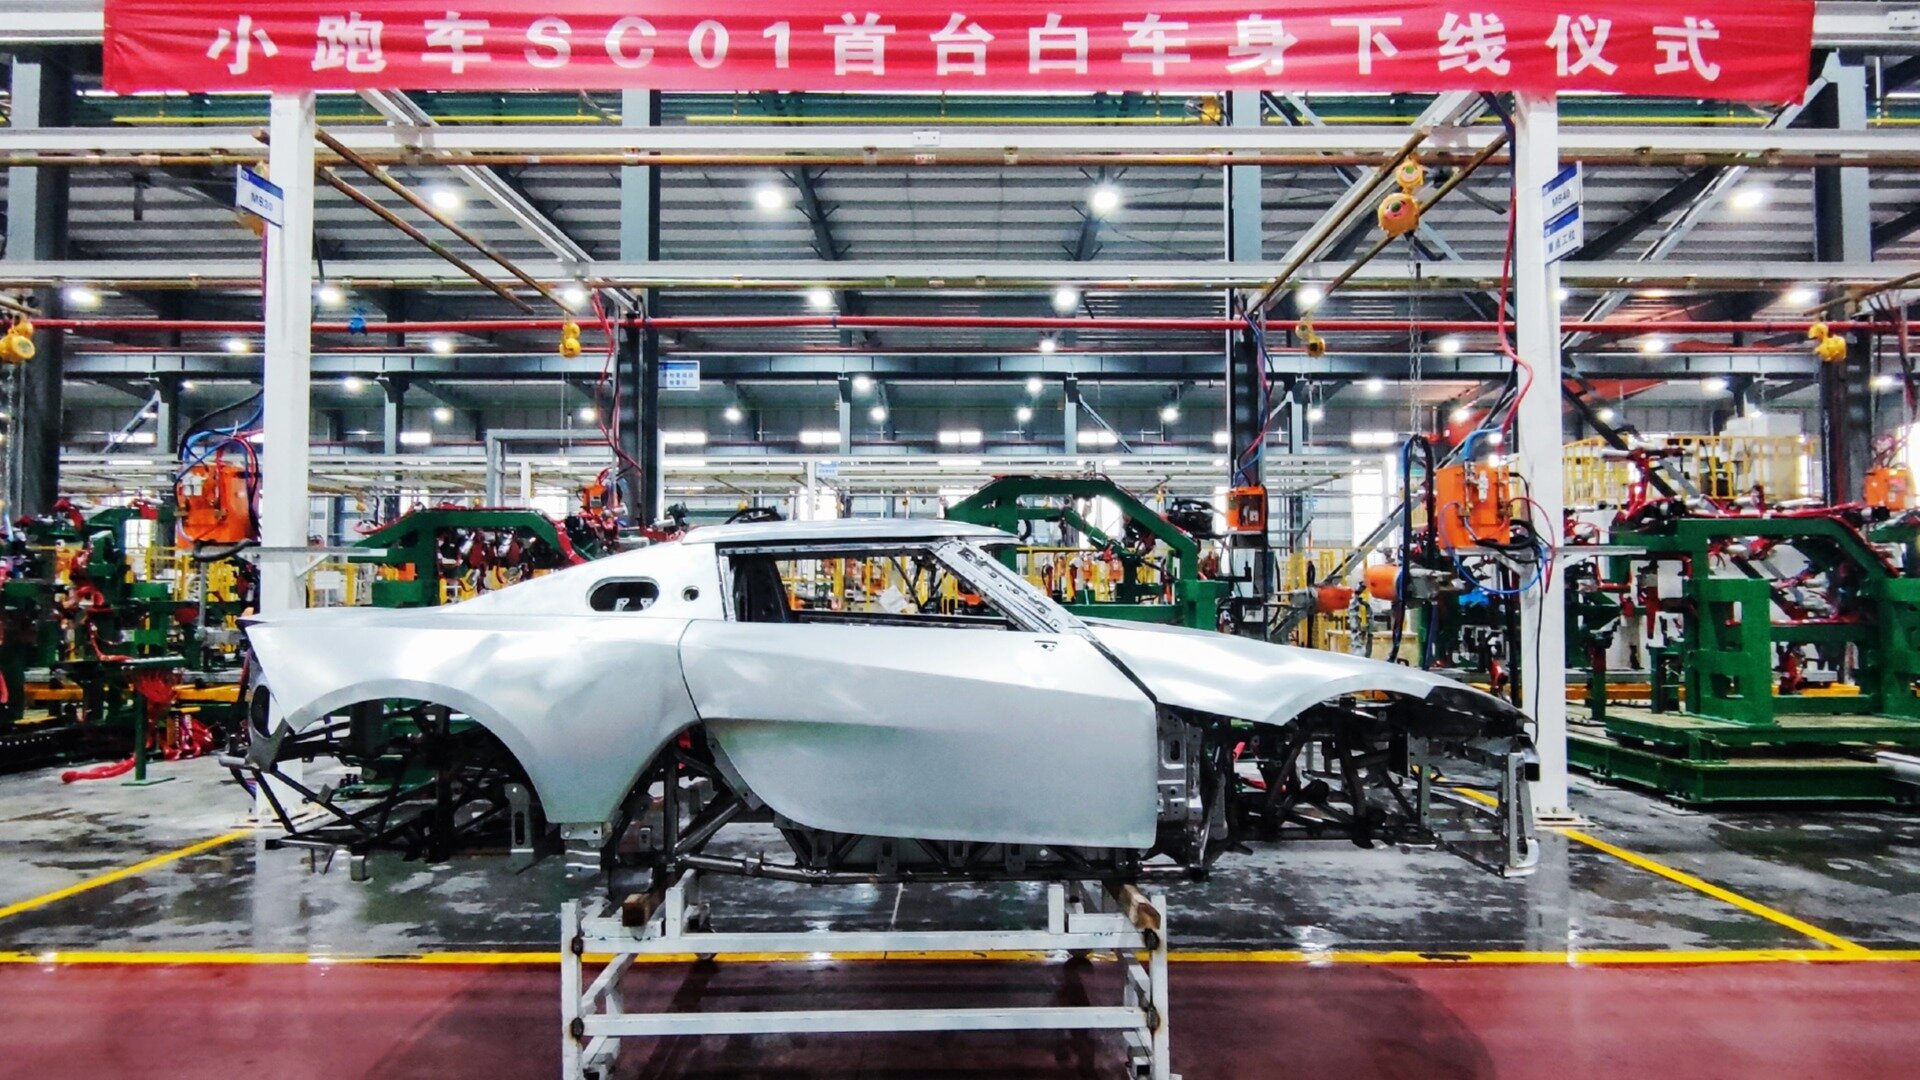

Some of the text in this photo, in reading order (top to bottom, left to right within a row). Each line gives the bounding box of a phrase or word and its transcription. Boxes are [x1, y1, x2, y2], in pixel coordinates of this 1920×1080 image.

[206, 11, 1721, 82] 小跑车SC01首台白车身下线仪式
